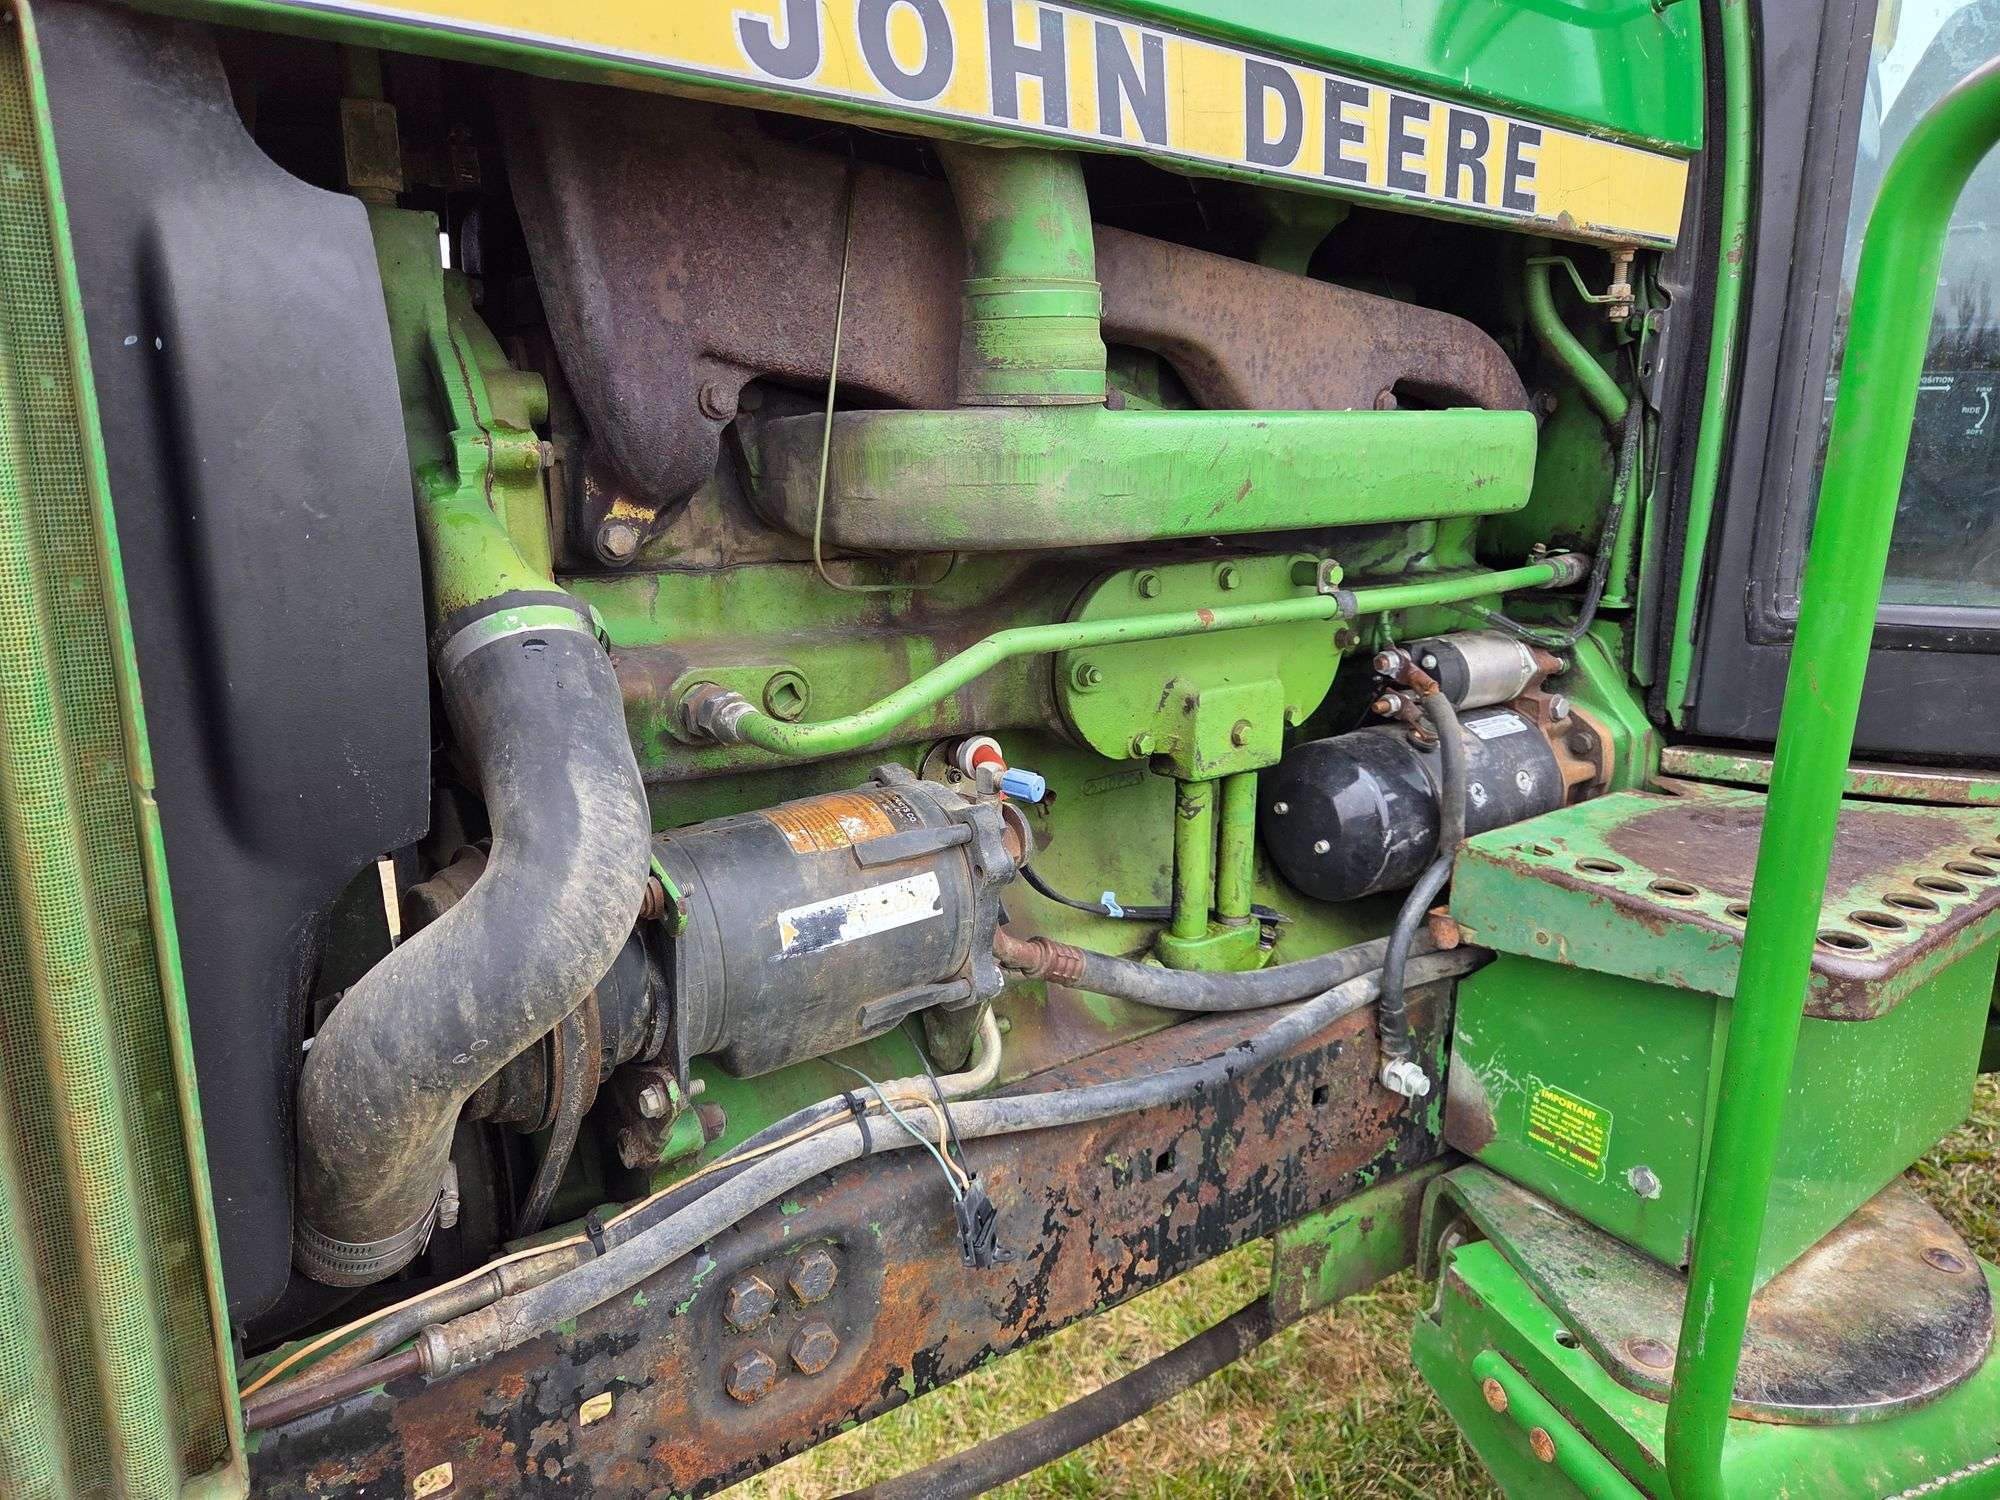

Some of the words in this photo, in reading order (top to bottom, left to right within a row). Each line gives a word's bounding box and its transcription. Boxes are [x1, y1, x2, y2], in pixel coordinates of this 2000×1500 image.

[738, 0, 1168, 146] JOHN
[1245, 58, 1542, 213] DEERE
[1920, 376, 1954, 384] OSITION
[1961, 406, 1981, 414] RIDE
[1541, 1088, 1597, 1121] IMPORTANT
